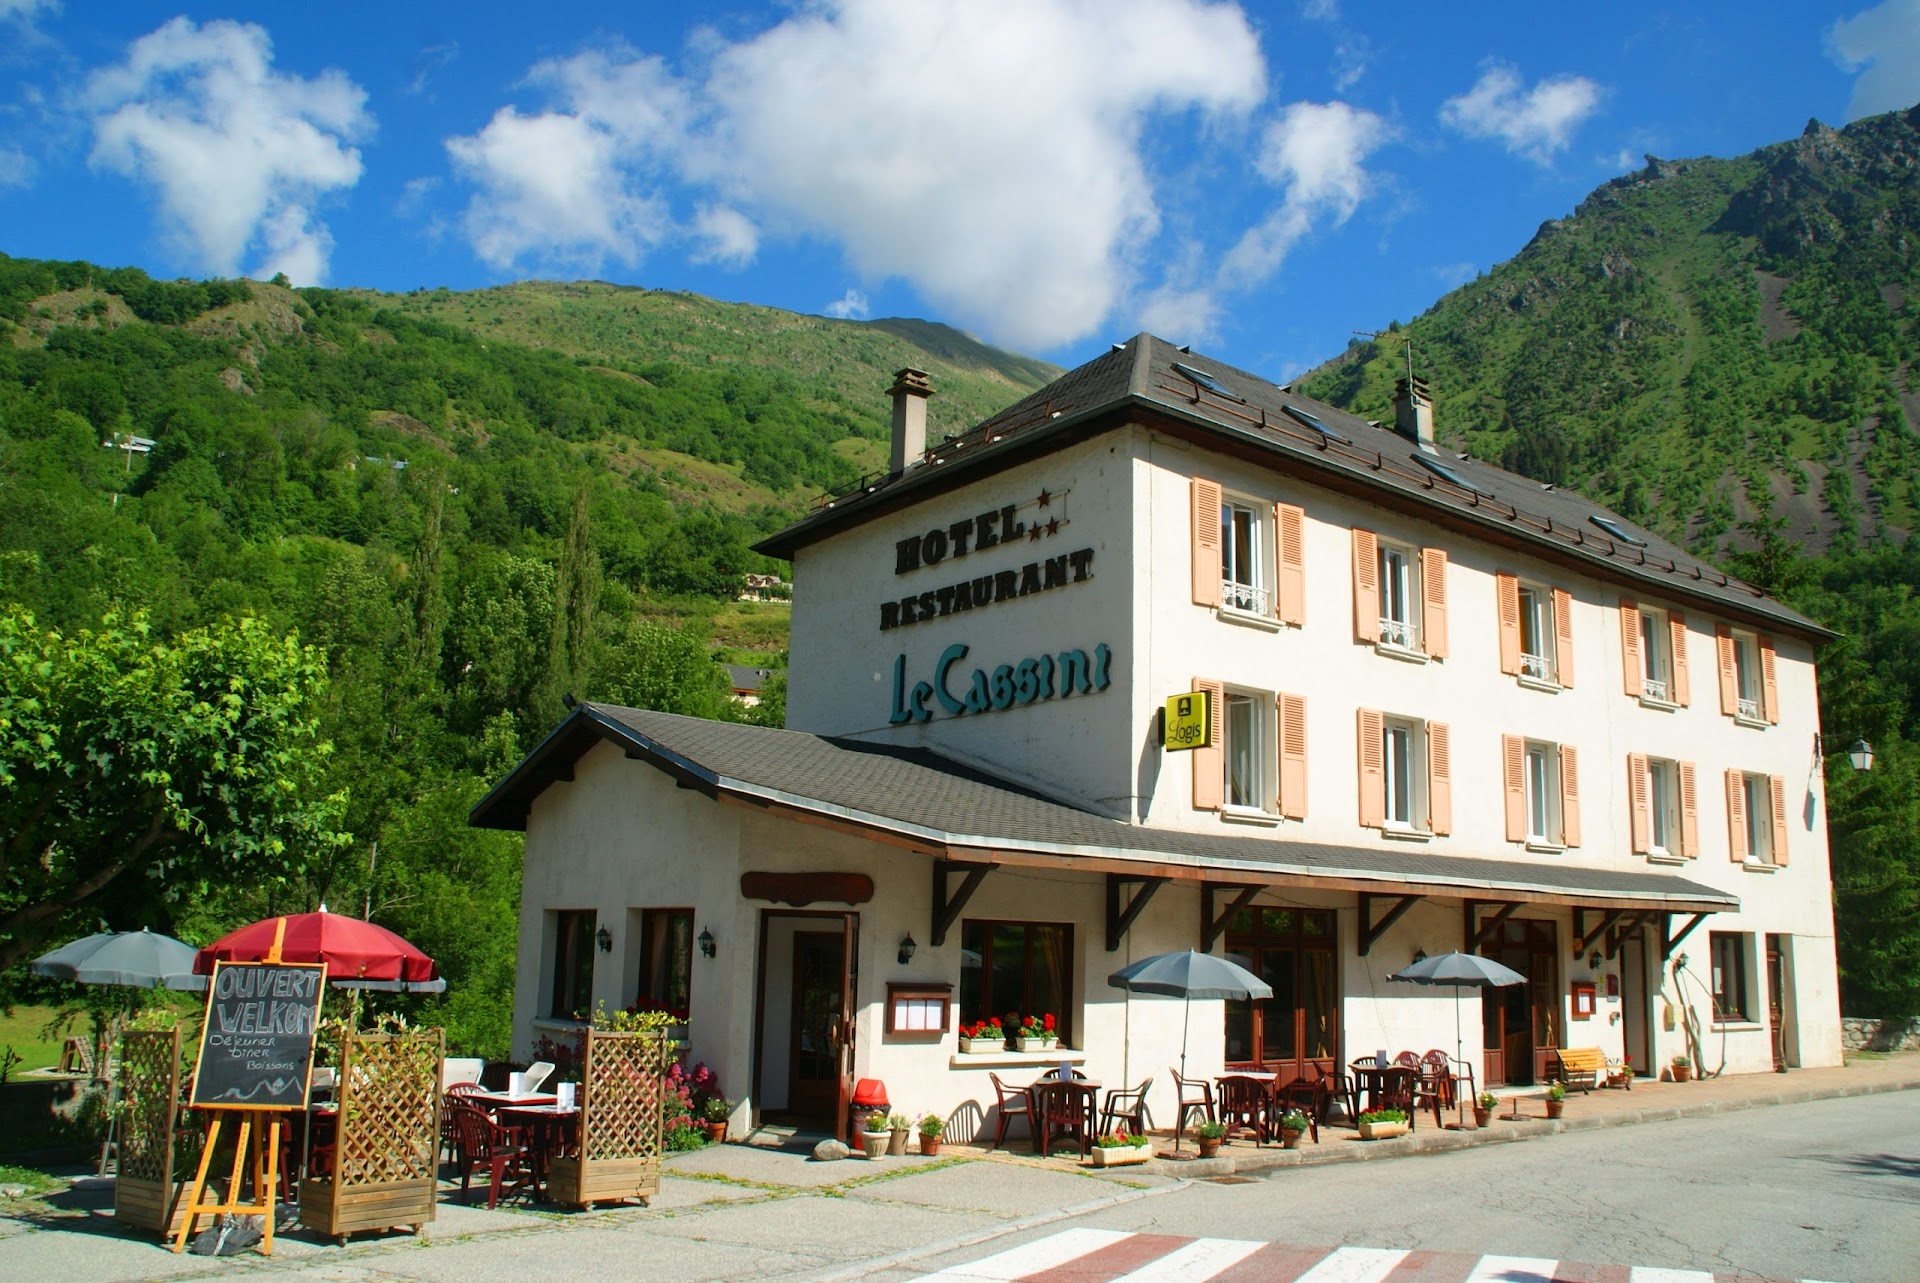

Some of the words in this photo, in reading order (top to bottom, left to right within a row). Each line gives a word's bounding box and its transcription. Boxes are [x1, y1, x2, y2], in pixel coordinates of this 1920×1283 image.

[895, 504, 1024, 575] HOTEL
[880, 547, 1094, 631] RESTAURANT
[889, 654, 933, 724] Le
[934, 643, 1112, 714] Cassini
[1167, 718, 1201, 744] Logis
[216, 967, 321, 999] OUVERT
[217, 1001, 318, 1035] WELKOM
[247, 1060, 294, 1071] Boissons
